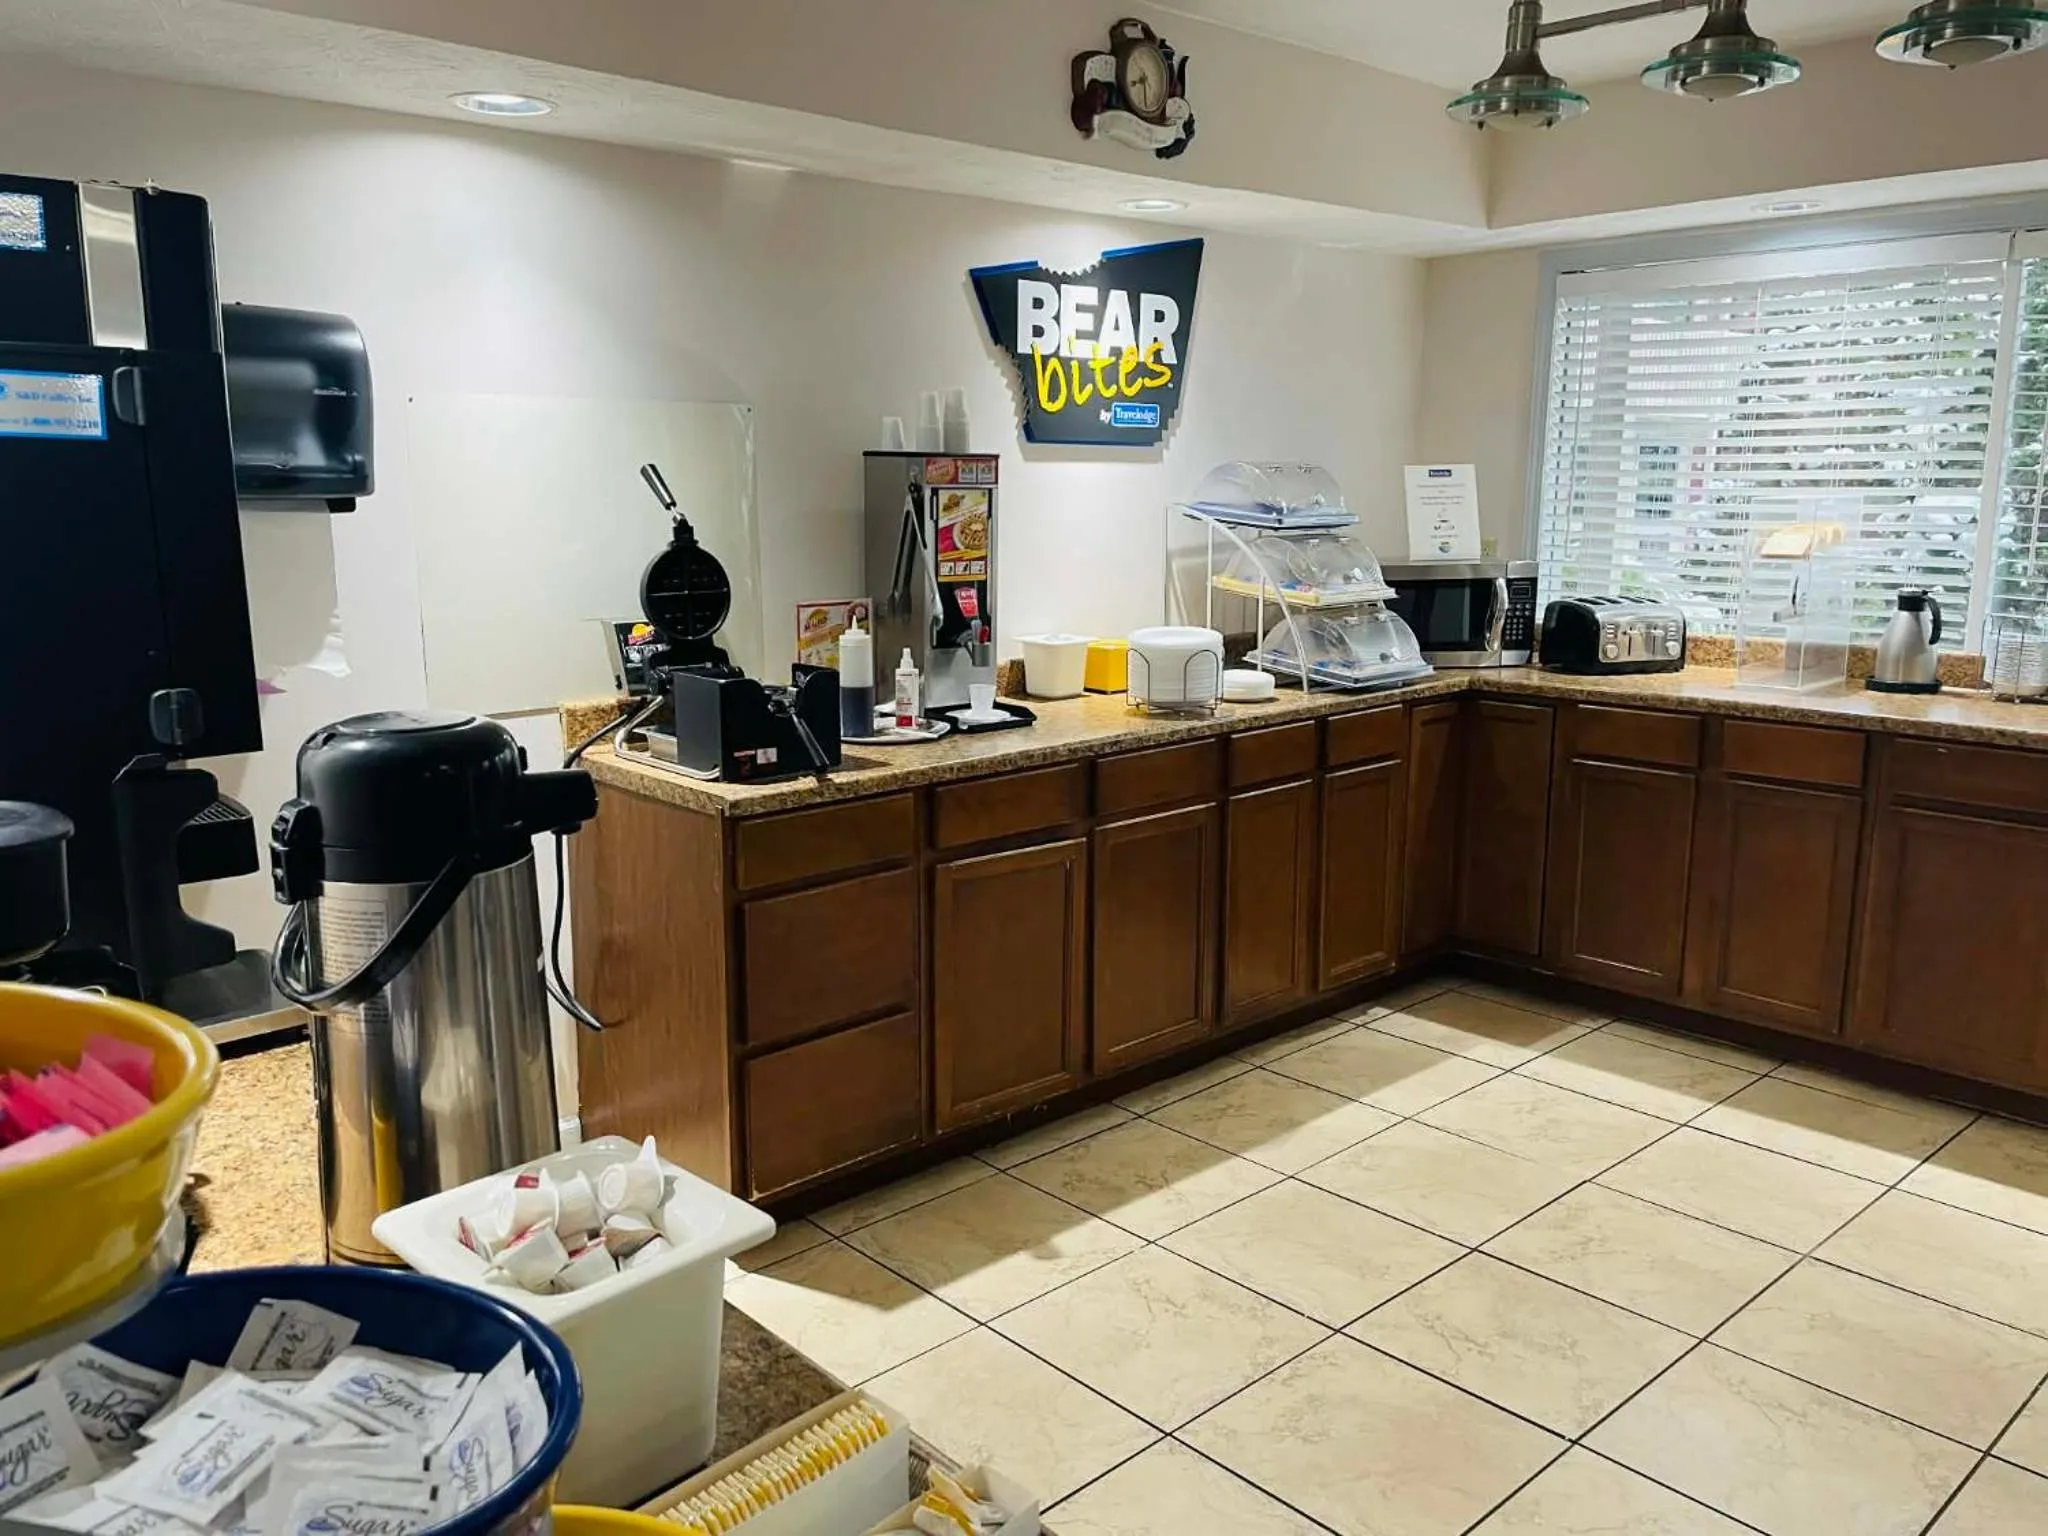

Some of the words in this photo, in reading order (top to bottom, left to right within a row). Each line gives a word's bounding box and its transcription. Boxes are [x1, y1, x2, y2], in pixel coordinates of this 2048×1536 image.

[1016, 279, 1180, 364] BEAR
[1030, 336, 1174, 412] bites
[1099, 408, 1112, 424] by
[1114, 406, 1156, 424] Travelodge
[364, 1372, 427, 1419] Sugar
[0, 1427, 50, 1487] ugar
